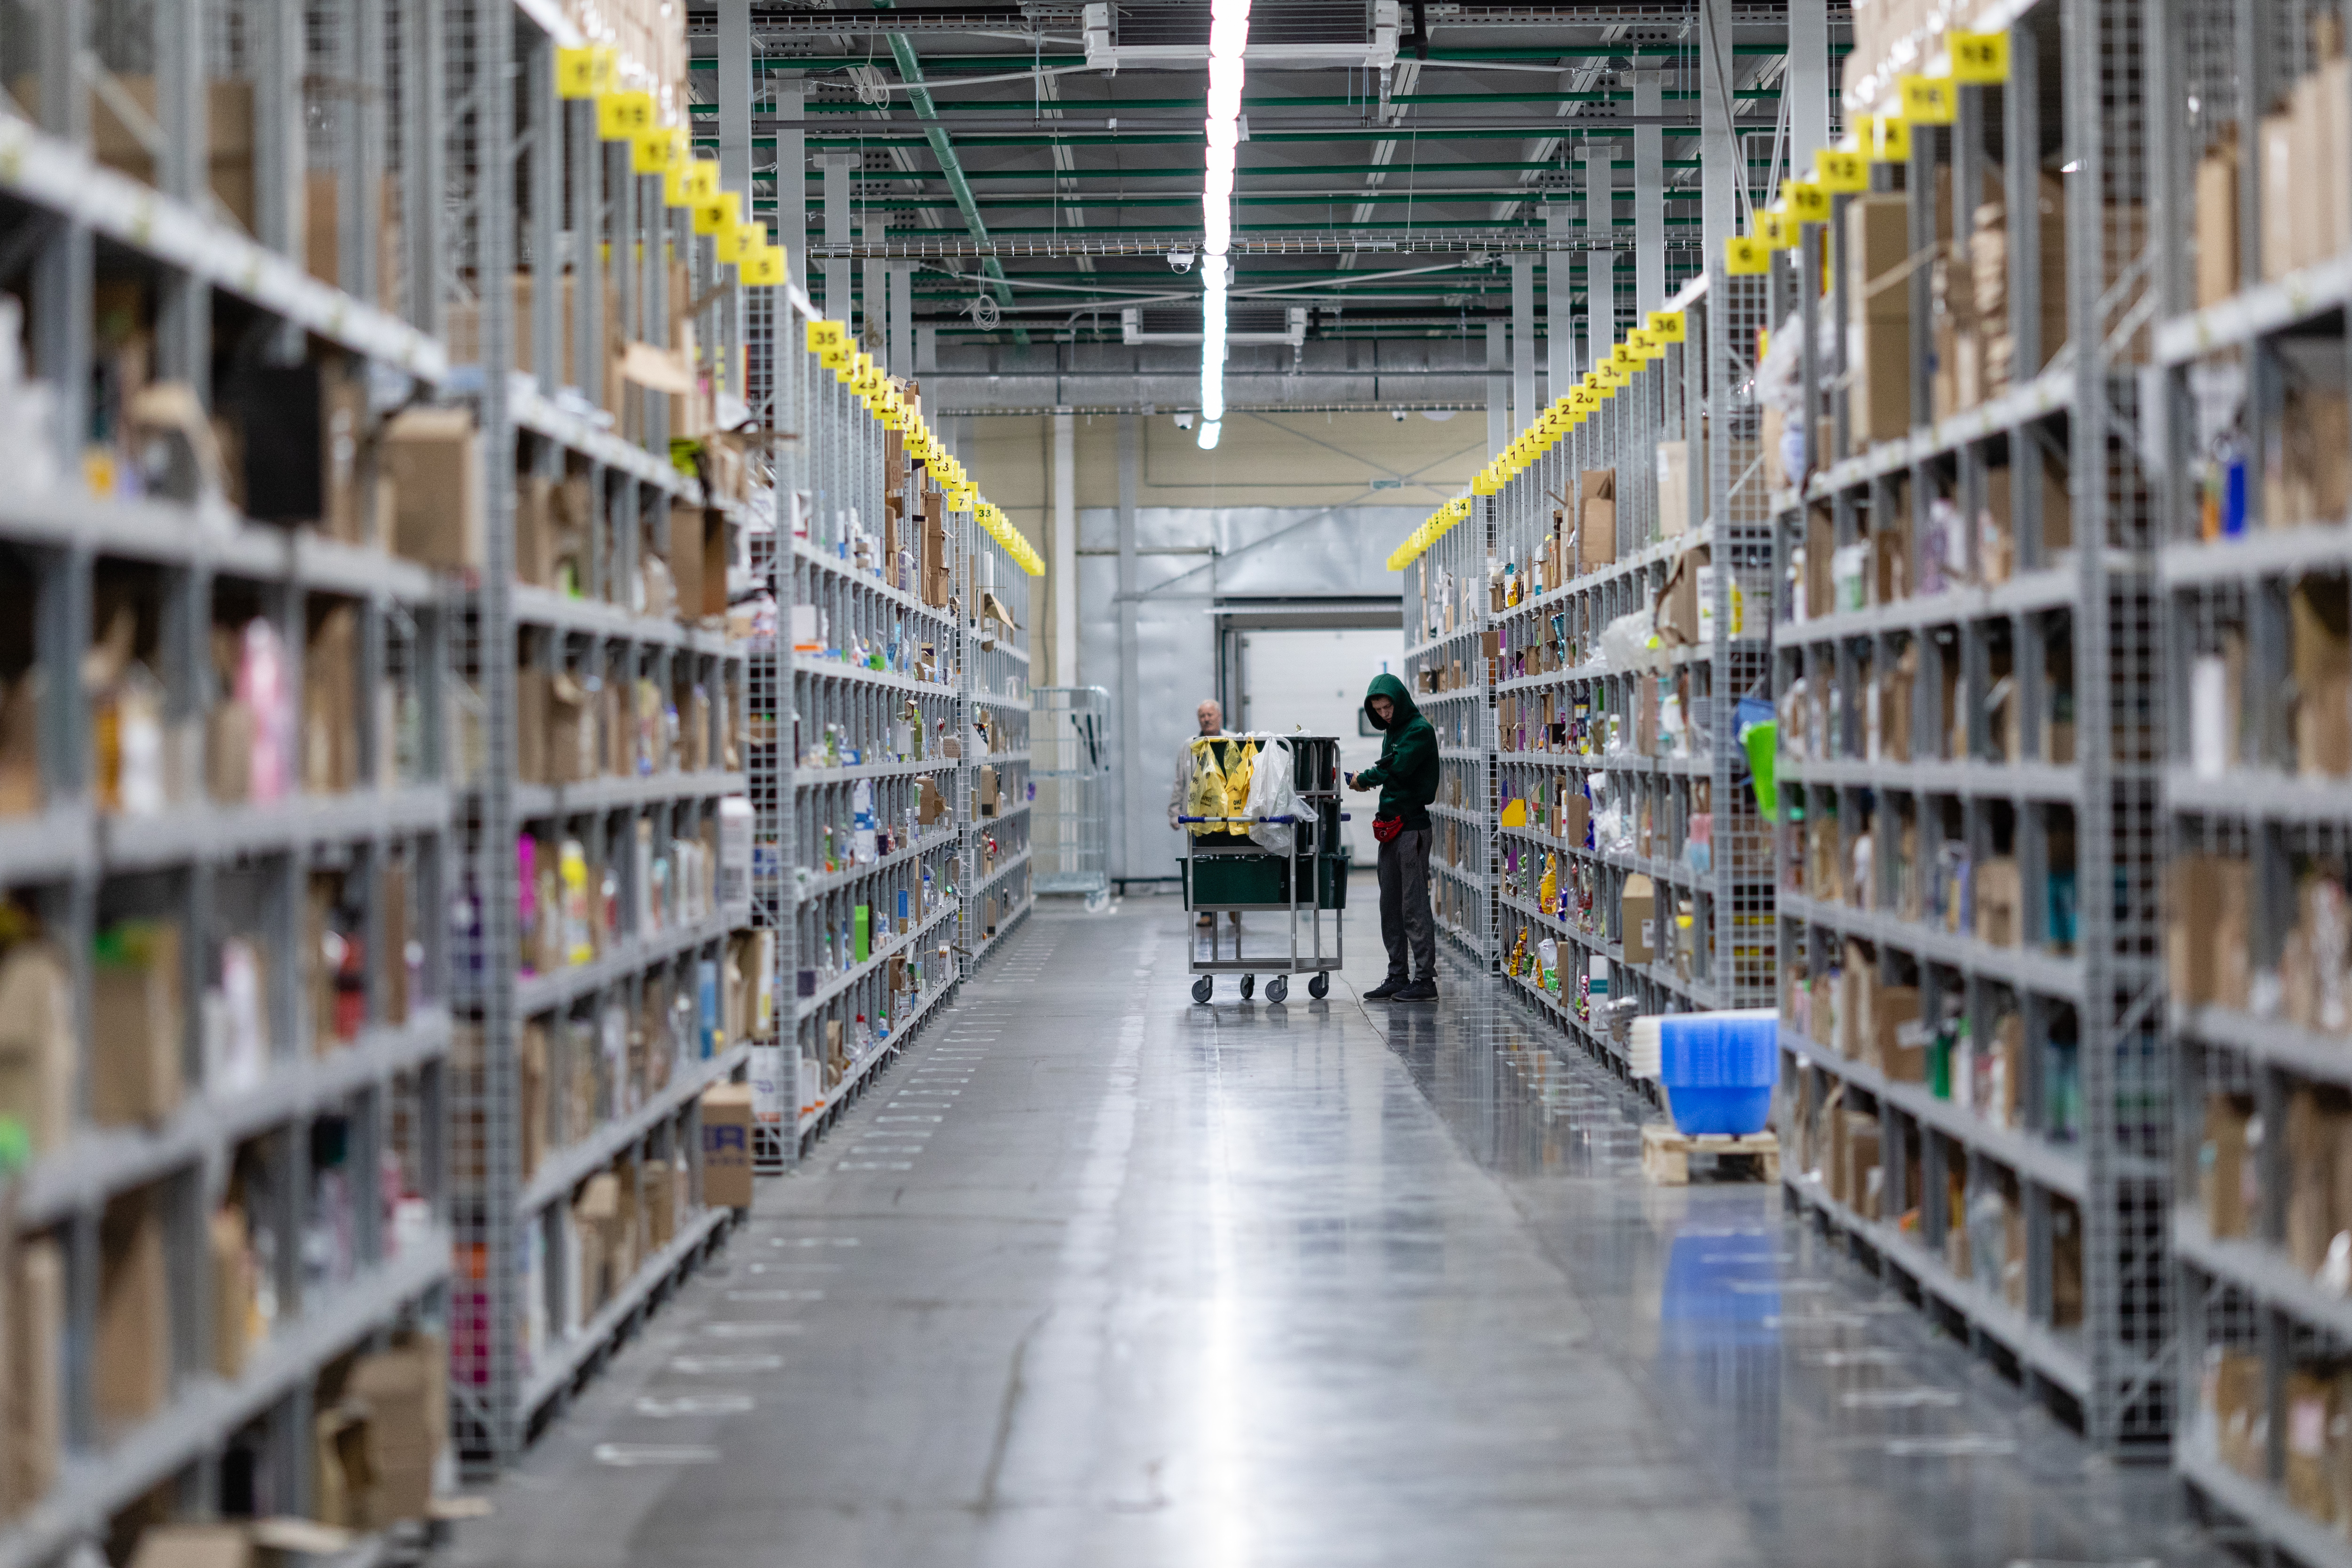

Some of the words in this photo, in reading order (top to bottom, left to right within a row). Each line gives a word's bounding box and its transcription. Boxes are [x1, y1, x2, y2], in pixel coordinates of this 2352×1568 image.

[1655, 319, 1676, 332] 36
[816, 332, 837, 344] 35
[1618, 351, 1637, 362] 3
[1590, 378, 1607, 389] 2
[1562, 404, 1579, 414] 2
[1549, 414, 1566, 424] 2
[1539, 424, 1554, 434] 2
